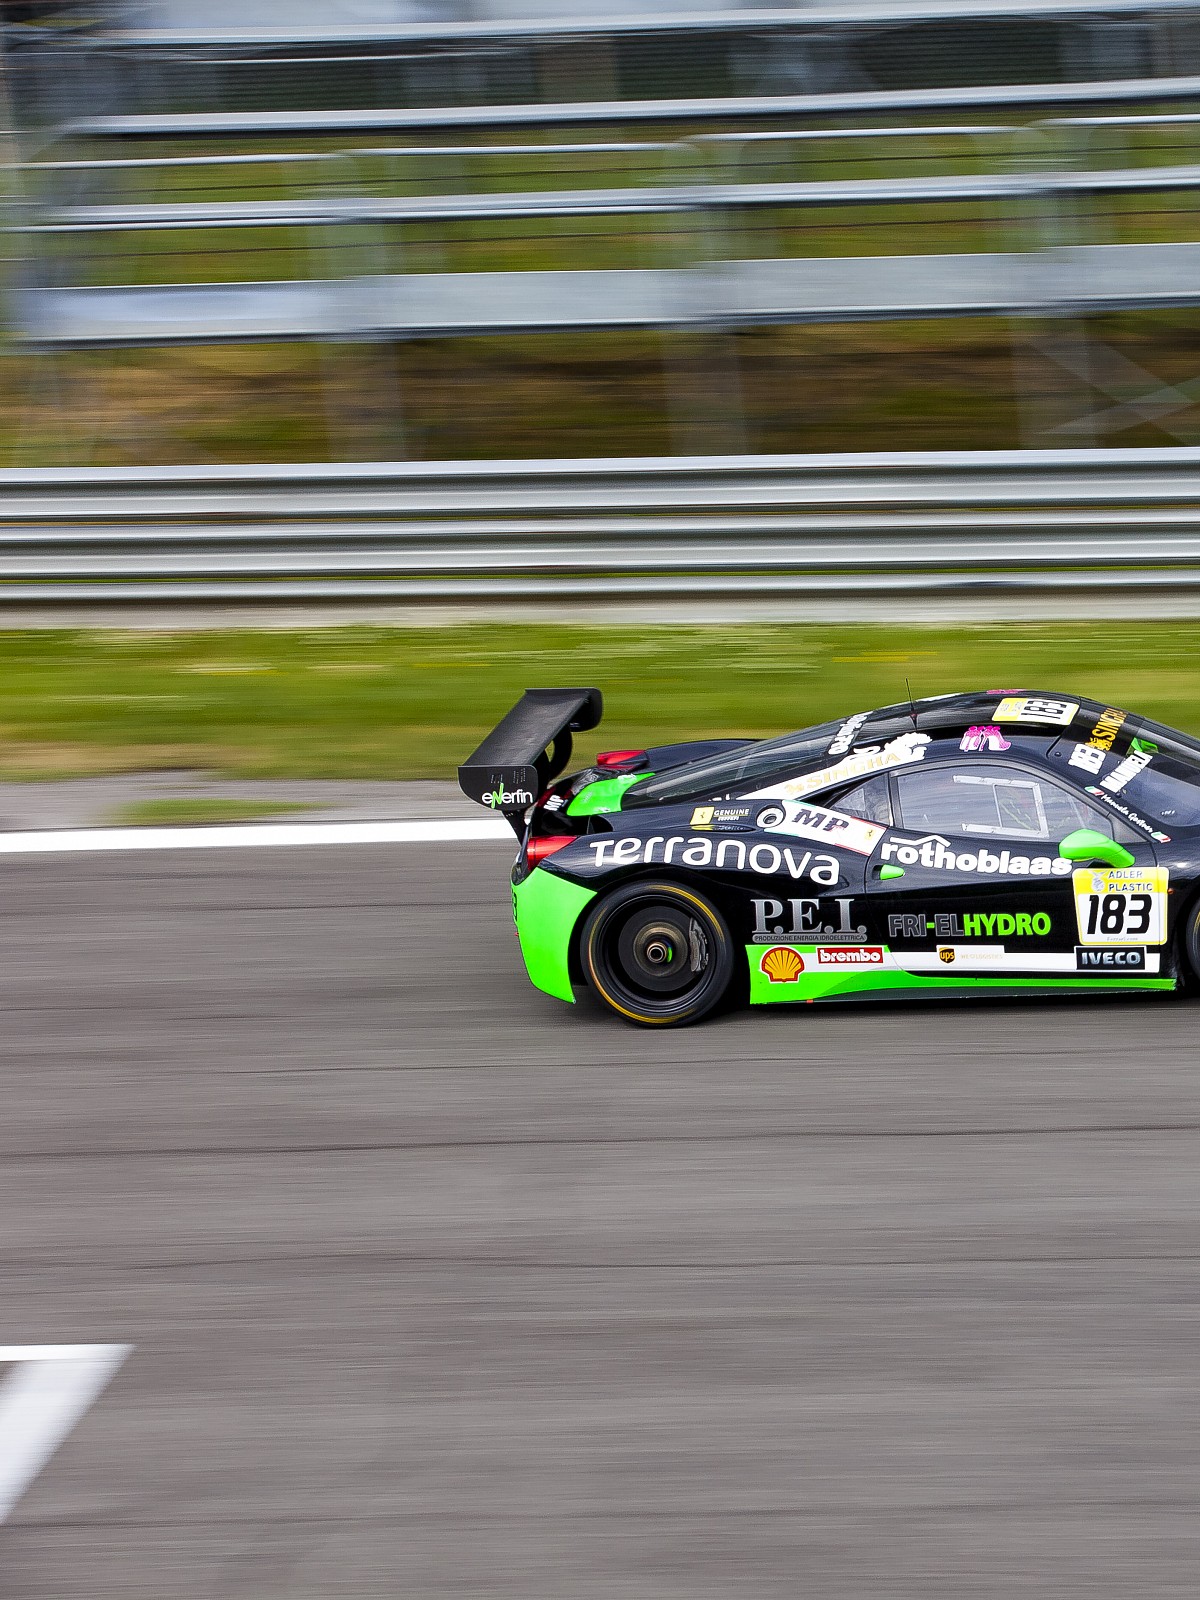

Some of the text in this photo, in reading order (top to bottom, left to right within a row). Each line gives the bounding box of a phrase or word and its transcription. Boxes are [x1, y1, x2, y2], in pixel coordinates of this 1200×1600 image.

[806, 752, 901, 788] SINGHA
[713, 808, 749, 816] GENUINE
[791, 808, 849, 832] MP
[880, 841, 1073, 875] rothoblaas
[1108, 870, 1143, 879] ADLER
[1108, 883, 1153, 892] PLASTIC
[750, 898, 867, 934] P.E.I.
[1087, 893, 1153, 935] 183
[820, 949, 881, 962] brembo
[940, 951, 955, 961] ups
[1081, 952, 1141, 965] IVECO
